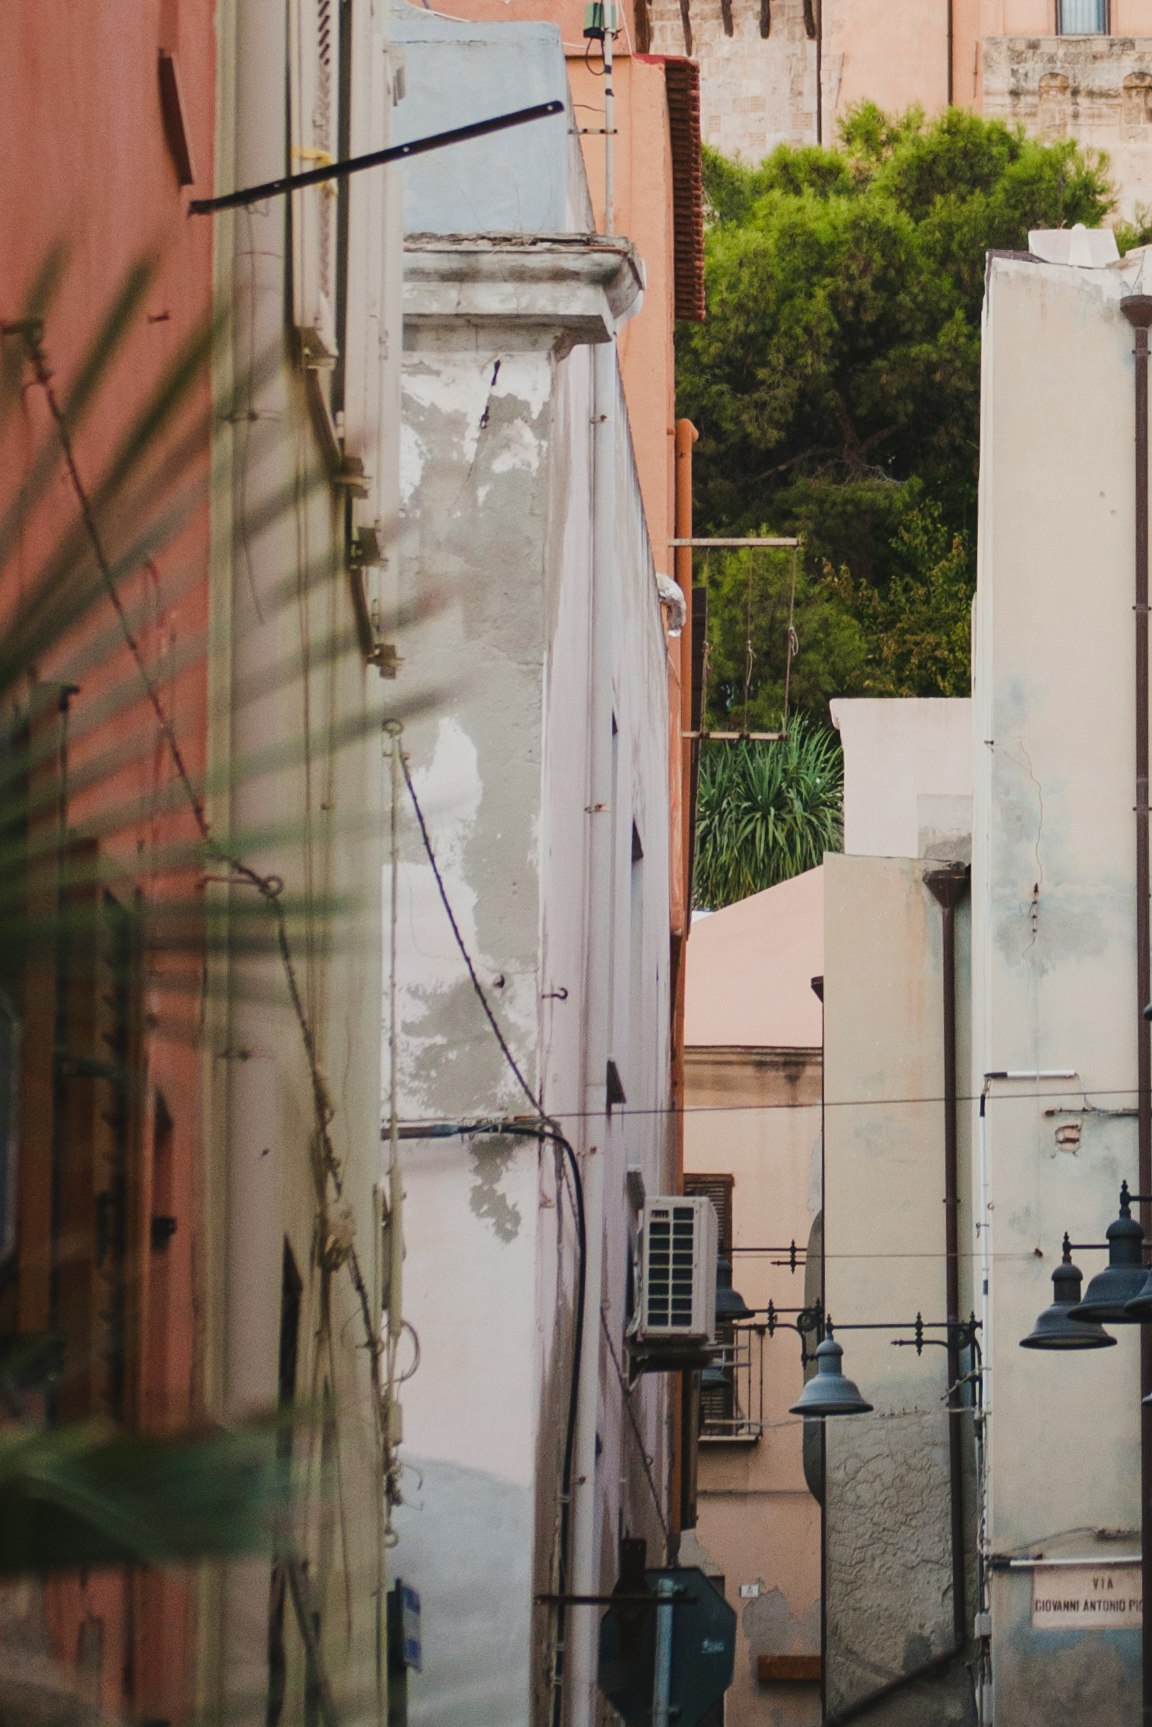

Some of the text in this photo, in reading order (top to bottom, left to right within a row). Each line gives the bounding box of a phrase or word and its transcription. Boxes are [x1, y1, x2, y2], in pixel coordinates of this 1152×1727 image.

[1092, 1577, 1114, 1590] VIA
[1035, 1599, 1080, 1613] GIOVANNI
[1083, 1599, 1126, 1613] ANTONIO
